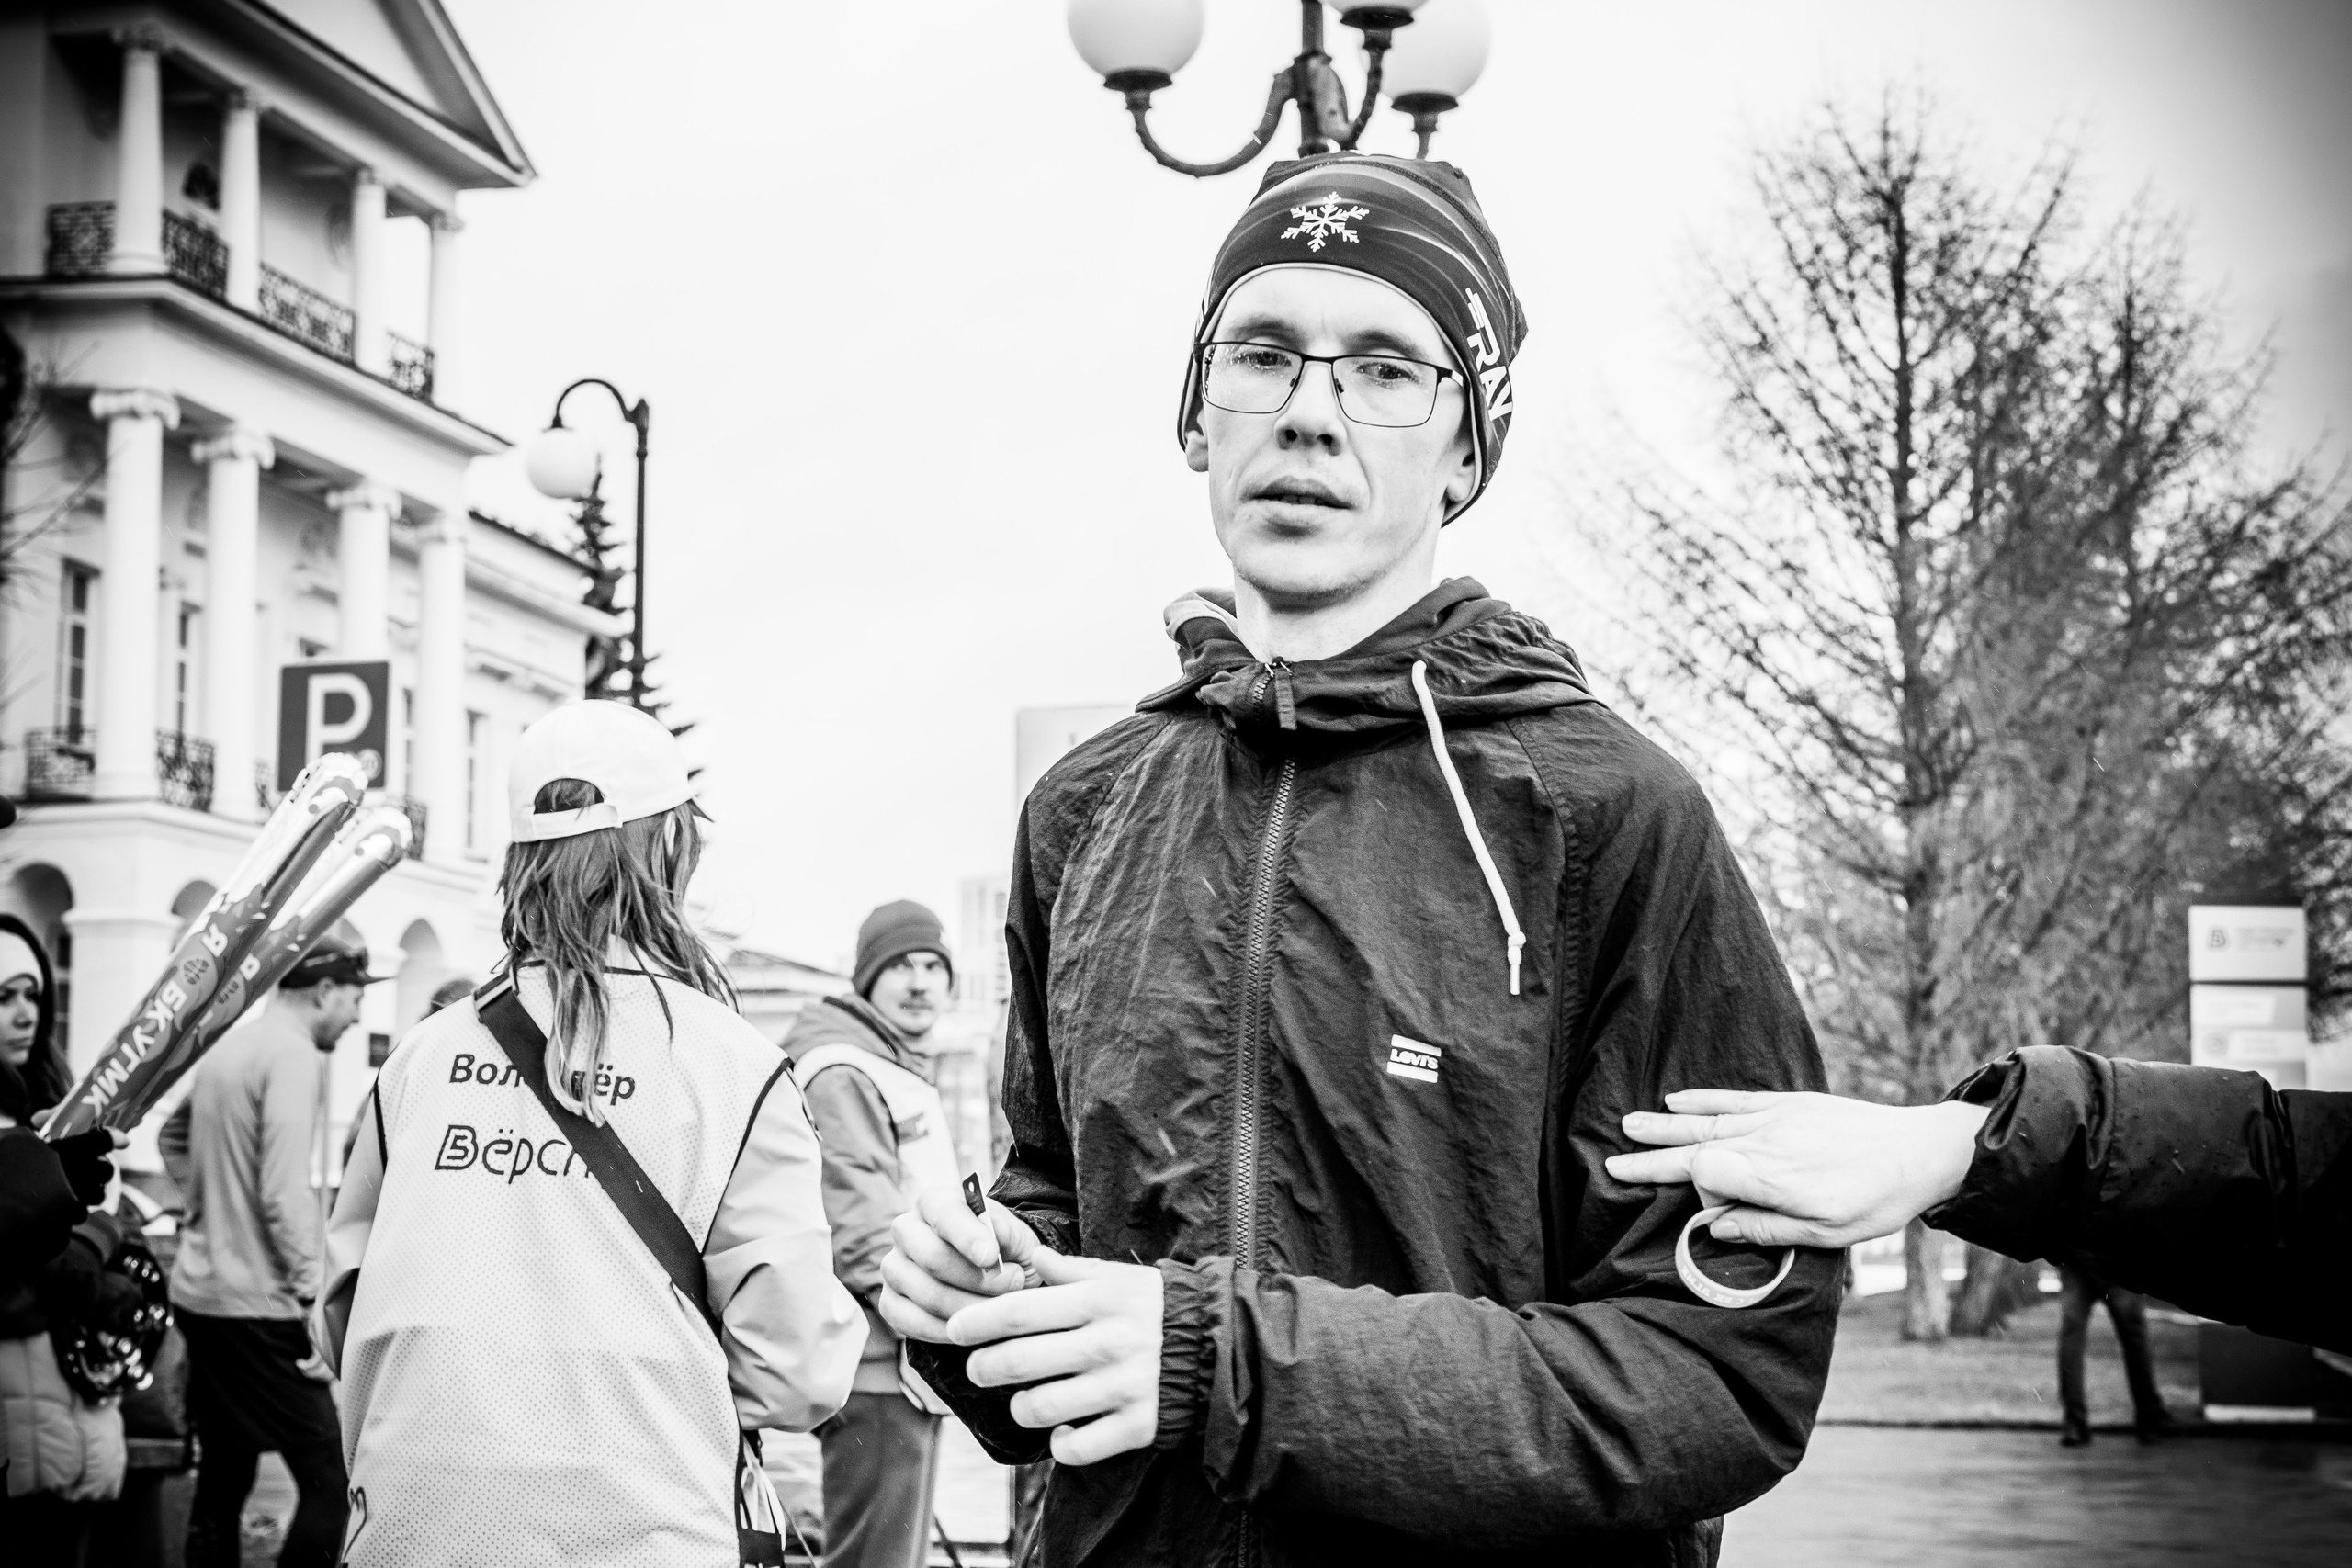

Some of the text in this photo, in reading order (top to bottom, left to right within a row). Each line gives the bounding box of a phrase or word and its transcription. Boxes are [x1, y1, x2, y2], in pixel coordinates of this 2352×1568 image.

[305, 672, 373, 770] P
[81, 923, 228, 1118] Я БК УГМК
